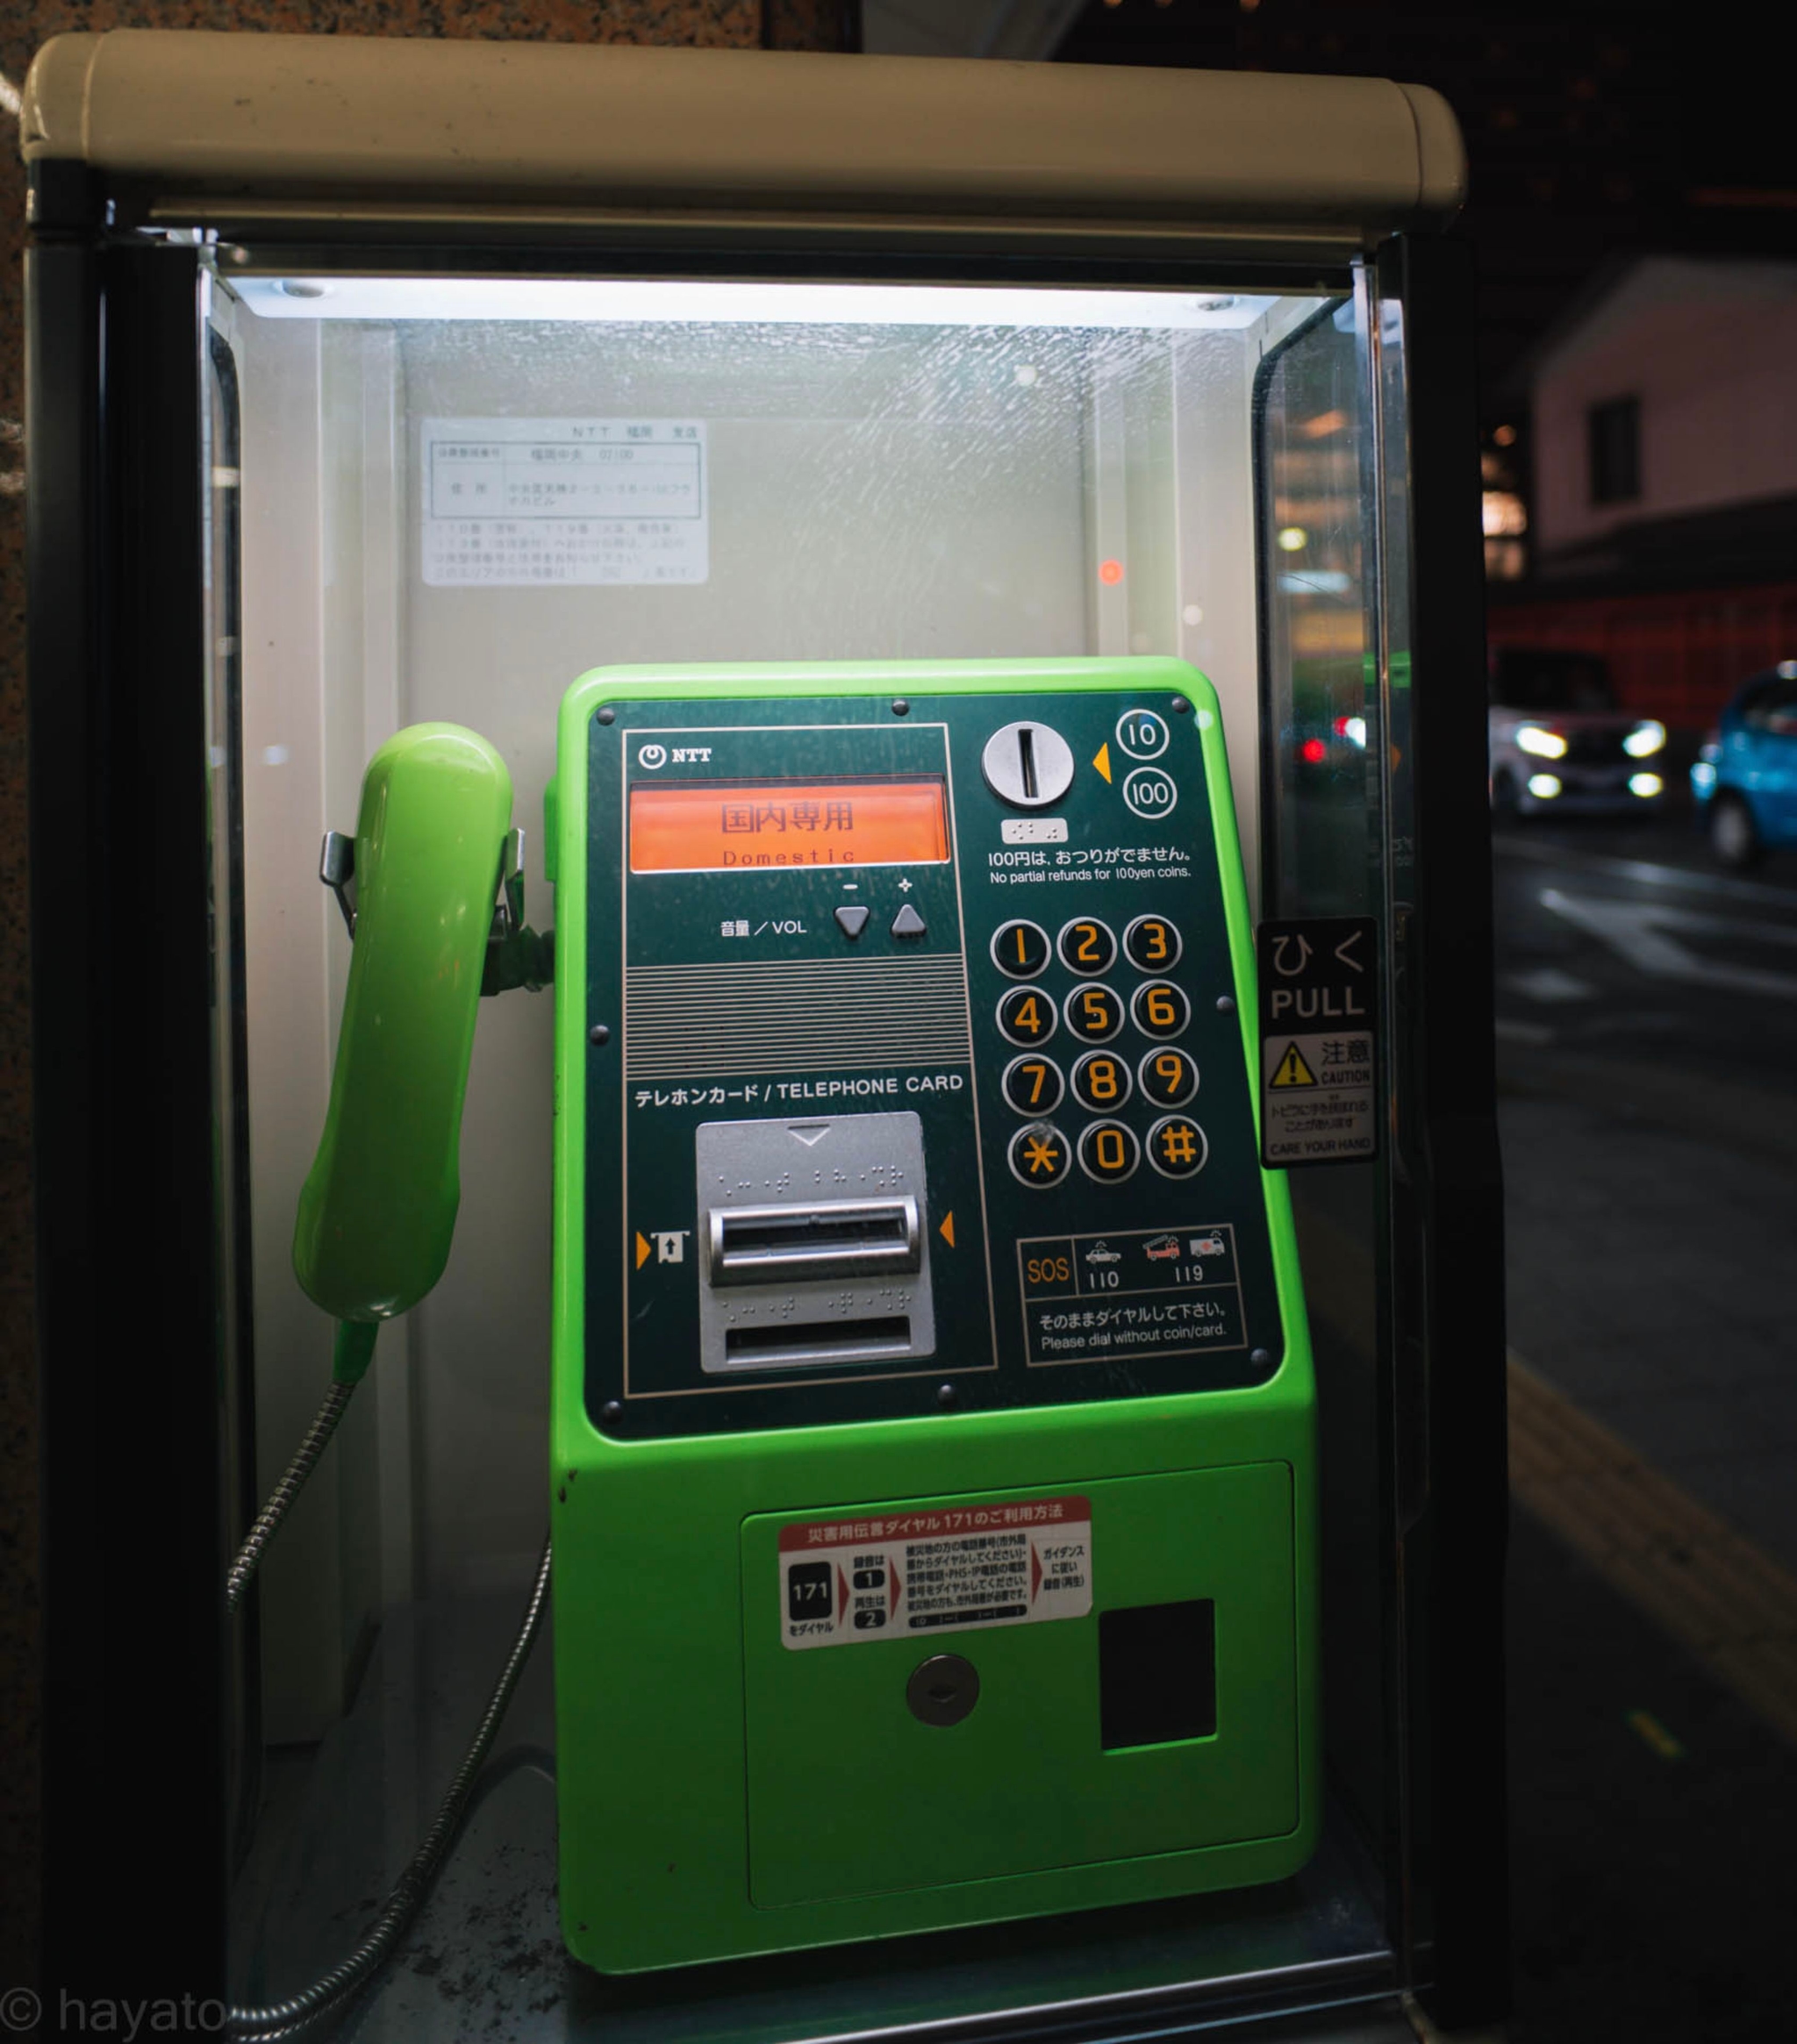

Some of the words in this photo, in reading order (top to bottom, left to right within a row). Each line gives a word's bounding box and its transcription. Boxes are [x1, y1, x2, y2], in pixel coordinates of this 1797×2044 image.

[1128, 724, 1156, 746] 10
[672, 748, 712, 762] NTT
[1133, 783, 1168, 804] 100
[722, 800, 853, 833] 国内専用
[723, 849, 854, 865] Domestic
[991, 872, 1006, 883] No
[1010, 870, 1045, 885] partial
[1049, 868, 1092, 881] refunds
[1094, 868, 1110, 880] for
[1116, 867, 1155, 882] 100yen
[1157, 866, 1191, 877] coins.
[1016, 928, 1026, 963] 1
[1075, 925, 1099, 961] 2
[1143, 924, 1167, 959] 3
[1014, 997, 1041, 1033] 4
[1084, 992, 1107, 1029] 5
[1148, 989, 1175, 1025] 6
[1272, 986, 1364, 1019] PULL
[1321, 1039, 1370, 1065] 注意
[1022, 1065, 1046, 1103] 7
[1089, 1061, 1117, 1098] 8
[1156, 1055, 1182, 1093] 9
[1321, 1069, 1370, 1085] CAUTION
[635, 1084, 758, 1107] テレホンカード
[777, 1078, 898, 1098] TELEPHONE
[906, 1075, 963, 1092] CARD
[1097, 1130, 1125, 1169] 0
[1271, 1142, 1300, 1155] CARE
[1304, 1140, 1335, 1153] YOUR
[1339, 1137, 1370, 1150] HAND
[1027, 1257, 1069, 1283] SOS
[1090, 1271, 1120, 1290] 110
[1175, 1265, 1203, 1283] 119
[1040, 1302, 1226, 1330] そのままダイヤルして下さい。
[1042, 1335, 1085, 1350] Please
[1089, 1333, 1111, 1346] dial
[1114, 1327, 1160, 1343] without
[1163, 1323, 1227, 1340] coin/card.
[793, 1582, 827, 1601] 171
[790, 1621, 833, 1638] をダイヤル
[866, 1612, 877, 1626] 2
